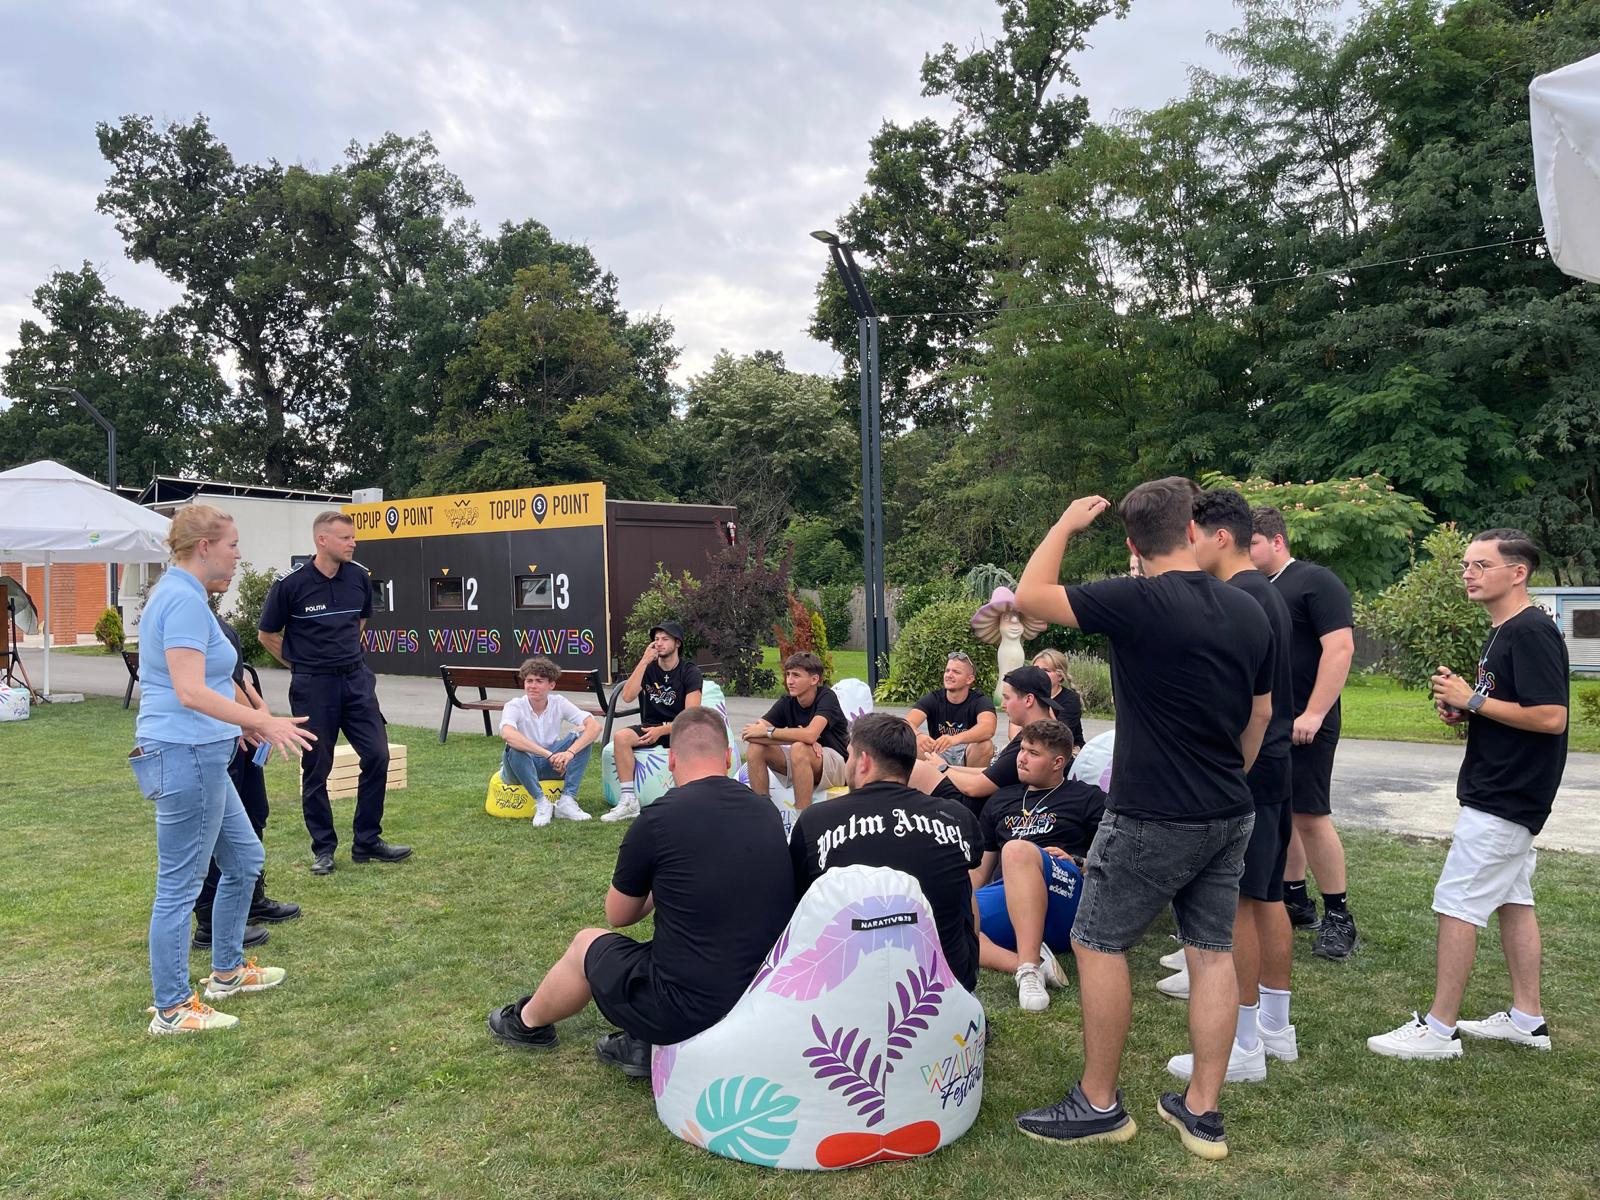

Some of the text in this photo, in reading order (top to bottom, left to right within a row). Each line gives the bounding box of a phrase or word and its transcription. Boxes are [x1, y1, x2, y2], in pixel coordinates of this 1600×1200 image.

[350, 511, 381, 530] TOPUP
[403, 506, 433, 526] POINT
[490, 499, 526, 520] TOPUP
[553, 493, 589, 516] POINT
[386, 579, 395, 612] 1
[466, 577, 479, 611] 2
[556, 573, 570, 610] 3
[360, 629, 419, 653] WAVES
[428, 629, 501, 654] WAVES
[514, 629, 595, 655] WAVES
[1004, 812, 1057, 829] WAVES
[892, 808, 971, 862] Angels
